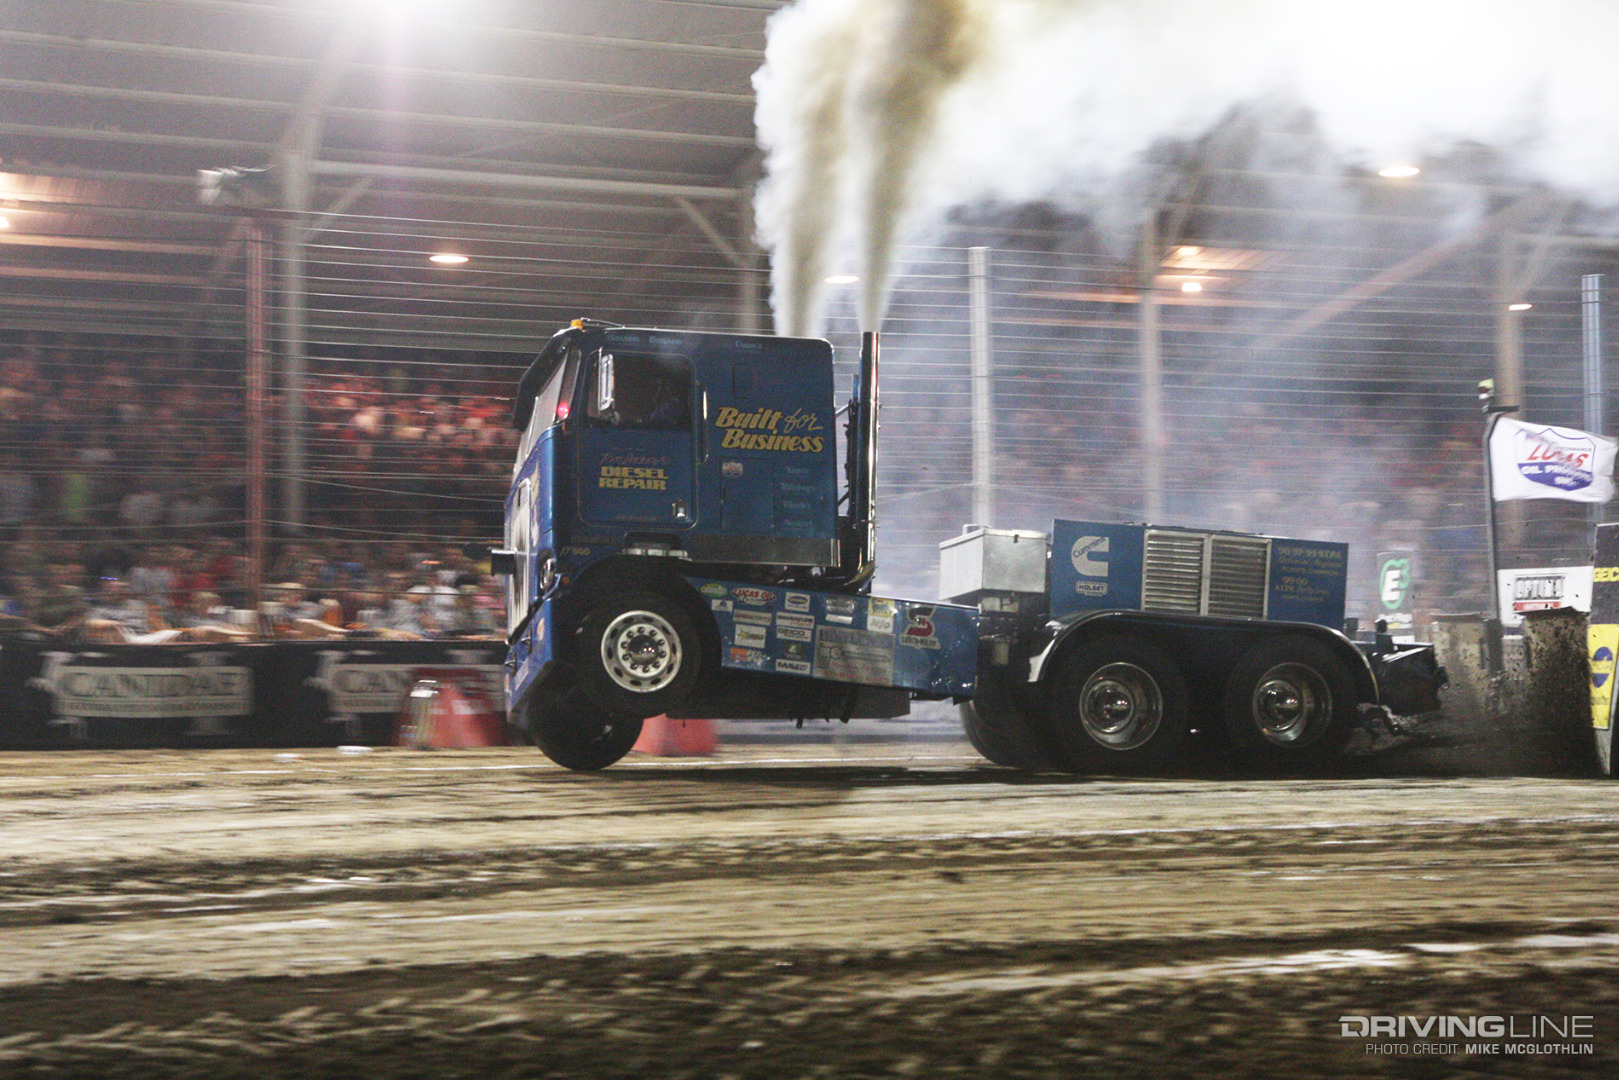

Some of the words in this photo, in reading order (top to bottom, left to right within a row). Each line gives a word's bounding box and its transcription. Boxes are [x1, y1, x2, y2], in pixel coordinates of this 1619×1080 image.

[715, 406, 784, 430] Built
[784, 408, 824, 434] for
[721, 428, 825, 453] Business
[601, 466, 669, 479] DIESEL
[599, 477, 667, 490] REPAIR
[1073, 536, 1106, 558] Cummins
[1593, 567, 1619, 582] GEIC
[1381, 569, 1401, 601] E
[733, 588, 760, 598] LUCAS
[760, 591, 775, 600] OIL
[777, 627, 806, 637] GEICO
